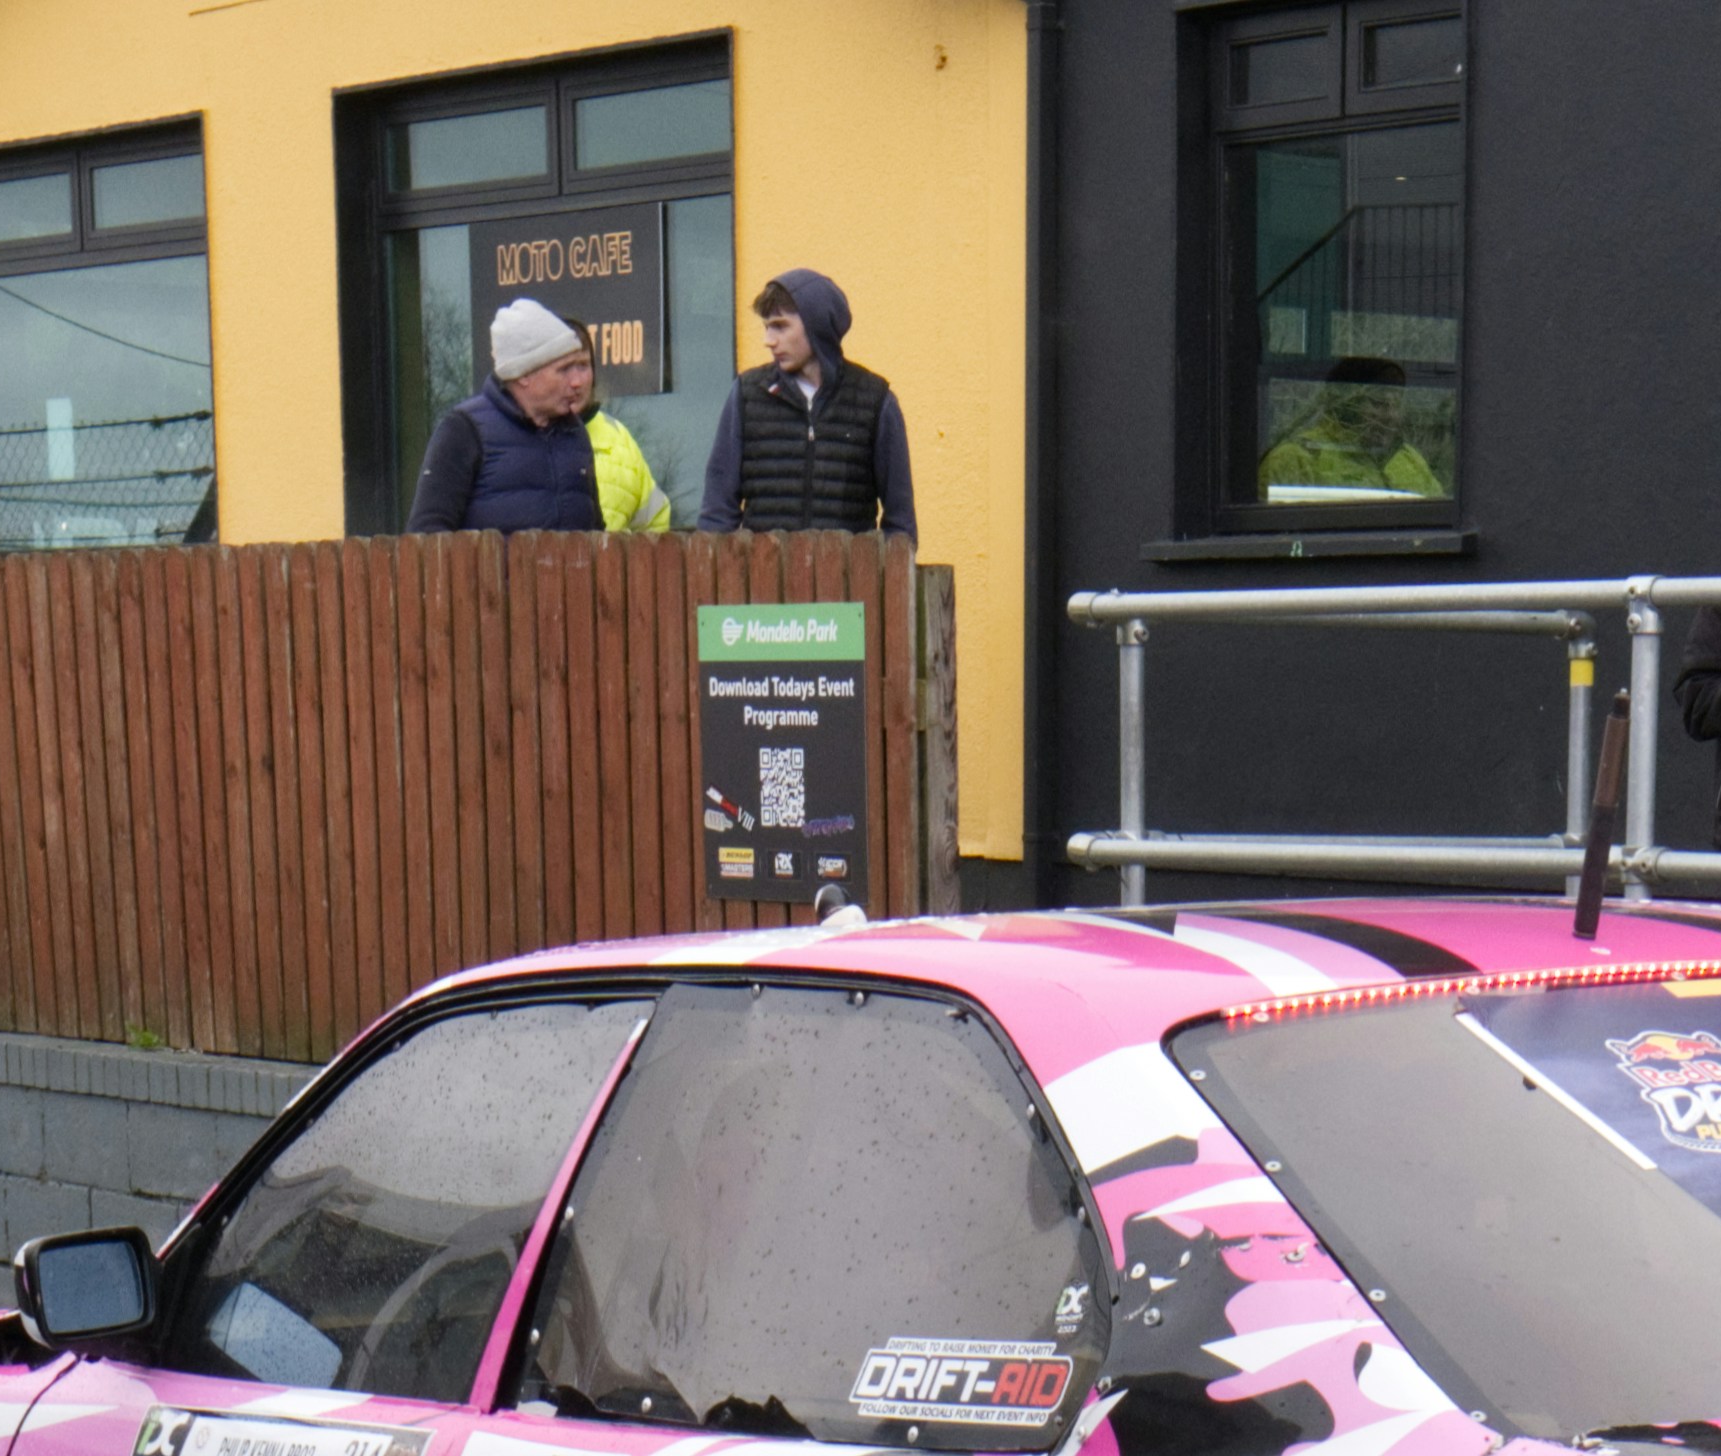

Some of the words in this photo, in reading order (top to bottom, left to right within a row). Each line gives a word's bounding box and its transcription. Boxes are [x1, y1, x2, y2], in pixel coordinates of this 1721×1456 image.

[497, 239, 564, 285] MOTO
[569, 231, 633, 278] CAFE
[601, 320, 644, 366] FOOD
[746, 618, 805, 643] Mondello
[807, 617, 839, 642] Park
[709, 676, 769, 697] Download
[771, 676, 815, 701] Todays
[818, 676, 855, 697] Event
[744, 705, 818, 730] Programme
[1635, 1061, 1706, 1089] Red
[888, 1339, 927, 1351] DRIFTING
[929, 1341, 941, 1352] TO
[943, 1342, 965, 1353] RAISE
[968, 1343, 997, 1354] MONEY
[999, 1344, 1015, 1355] FOR
[1018, 1344, 1056, 1356] CHARITY
[855, 1354, 1068, 1407] DRIFT-AID
[861, 1403, 897, 1414] FOLLOW
[899, 1405, 917, 1415] OUR
[919, 1406, 953, 1418] SOCIALS
[955, 1408, 973, 1418] FOR
[975, 1409, 996, 1420] NEXT
[997, 1410, 1025, 1421] EVENT
[1026, 1411, 1047, 1423] INFO
